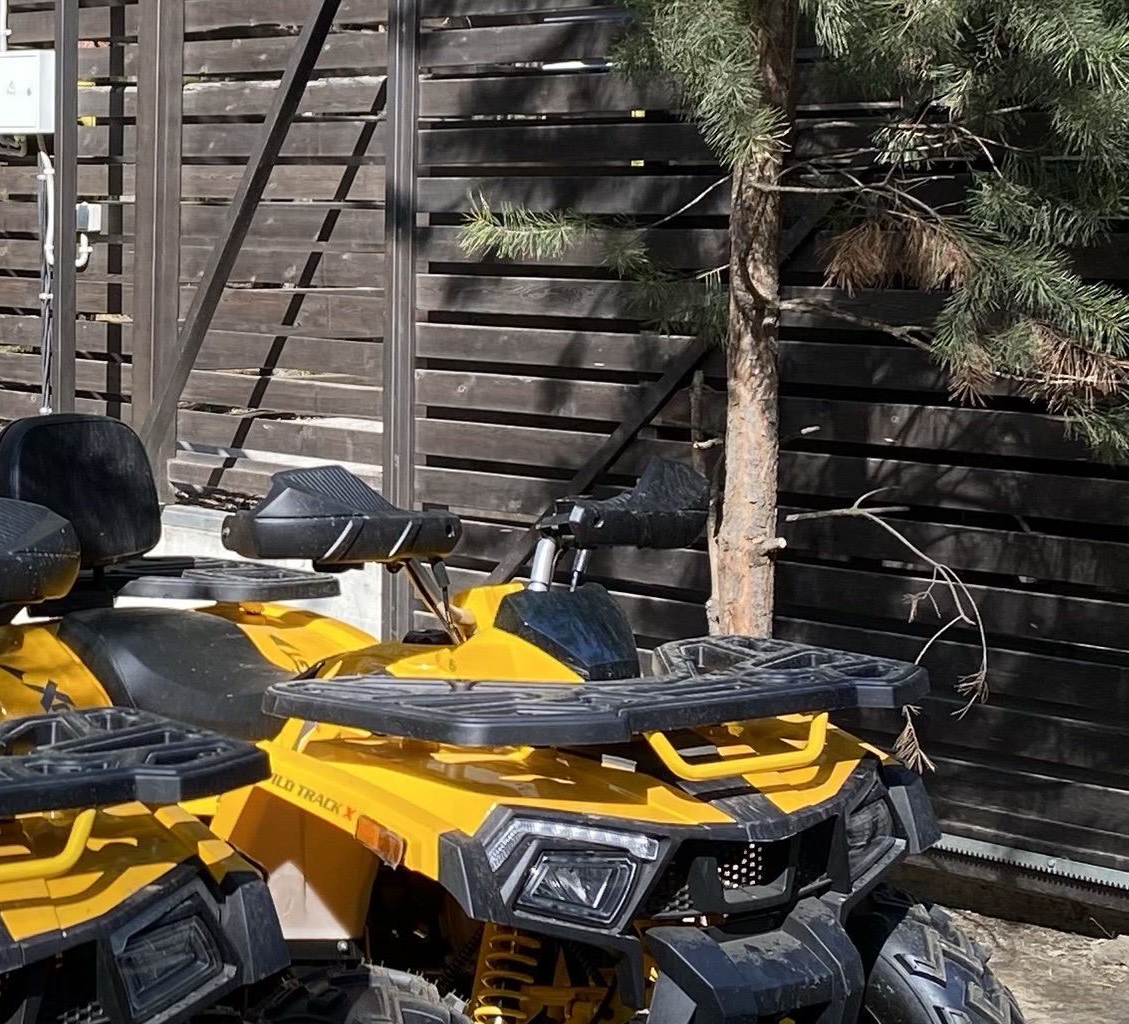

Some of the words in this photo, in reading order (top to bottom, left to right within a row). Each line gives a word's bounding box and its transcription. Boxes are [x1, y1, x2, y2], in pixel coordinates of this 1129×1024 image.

[271, 773, 295, 793] ILD
[297, 785, 342, 815] TRACK
[343, 806, 356, 821] X
